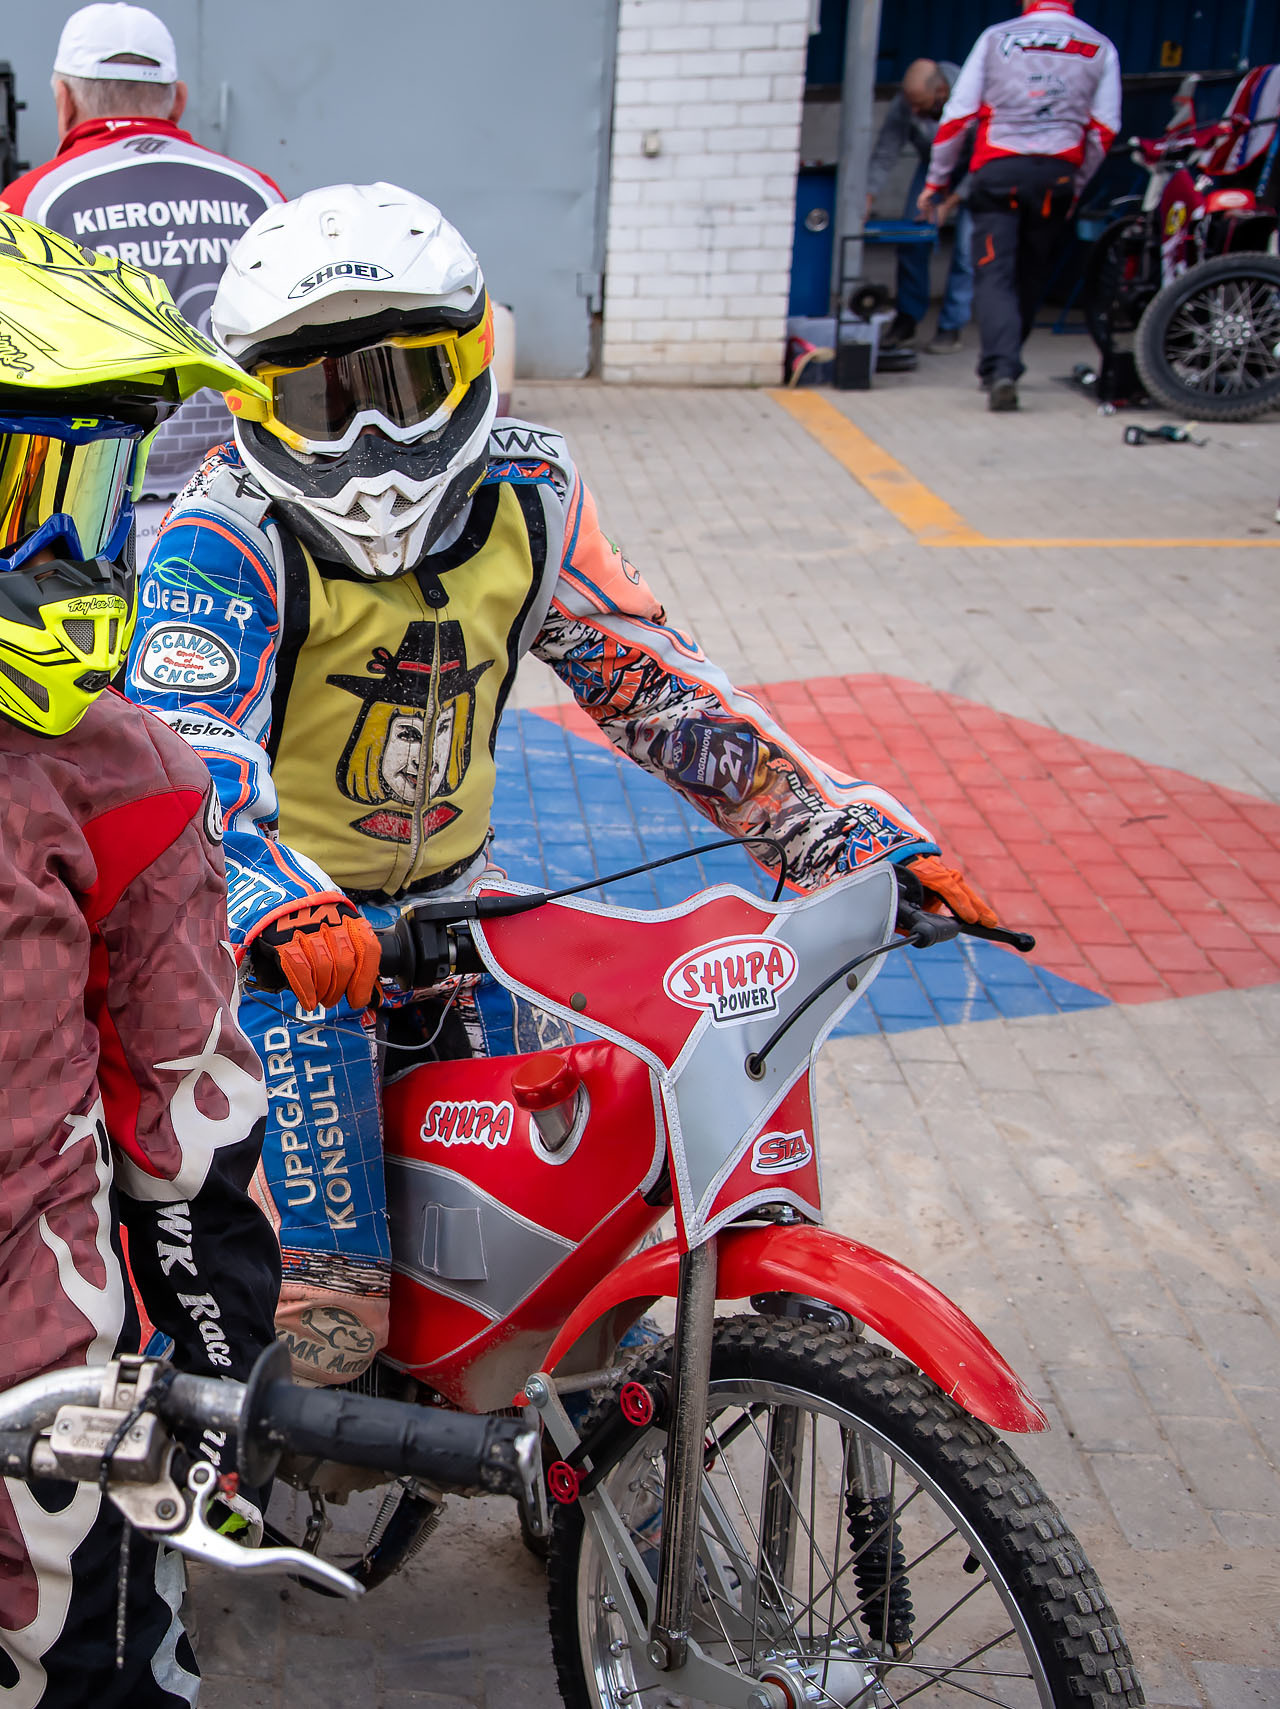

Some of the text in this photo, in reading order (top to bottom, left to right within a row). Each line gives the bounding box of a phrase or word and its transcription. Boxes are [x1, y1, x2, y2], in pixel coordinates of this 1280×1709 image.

[72, 199, 251, 235] KIEROWNIK
[300, 263, 378, 294] SHOEI
[142, 579, 254, 631] Clean R
[150, 633, 227, 667] SCANDIC
[153, 664, 196, 684] CNC
[696, 728, 713, 782] BOGDANOVS
[719, 739, 744, 783] 21
[682, 946, 784, 998] SHUPA
[718, 986, 769, 1014] POWER
[263, 1025, 317, 1208] UPPGÅRD
[423, 1105, 511, 1145] SHUPA
[303, 1059, 358, 1231] KONSULT
[758, 1135, 808, 1166] STA
[156, 1201, 199, 1277] WK
[176, 1291, 233, 1368] Race
